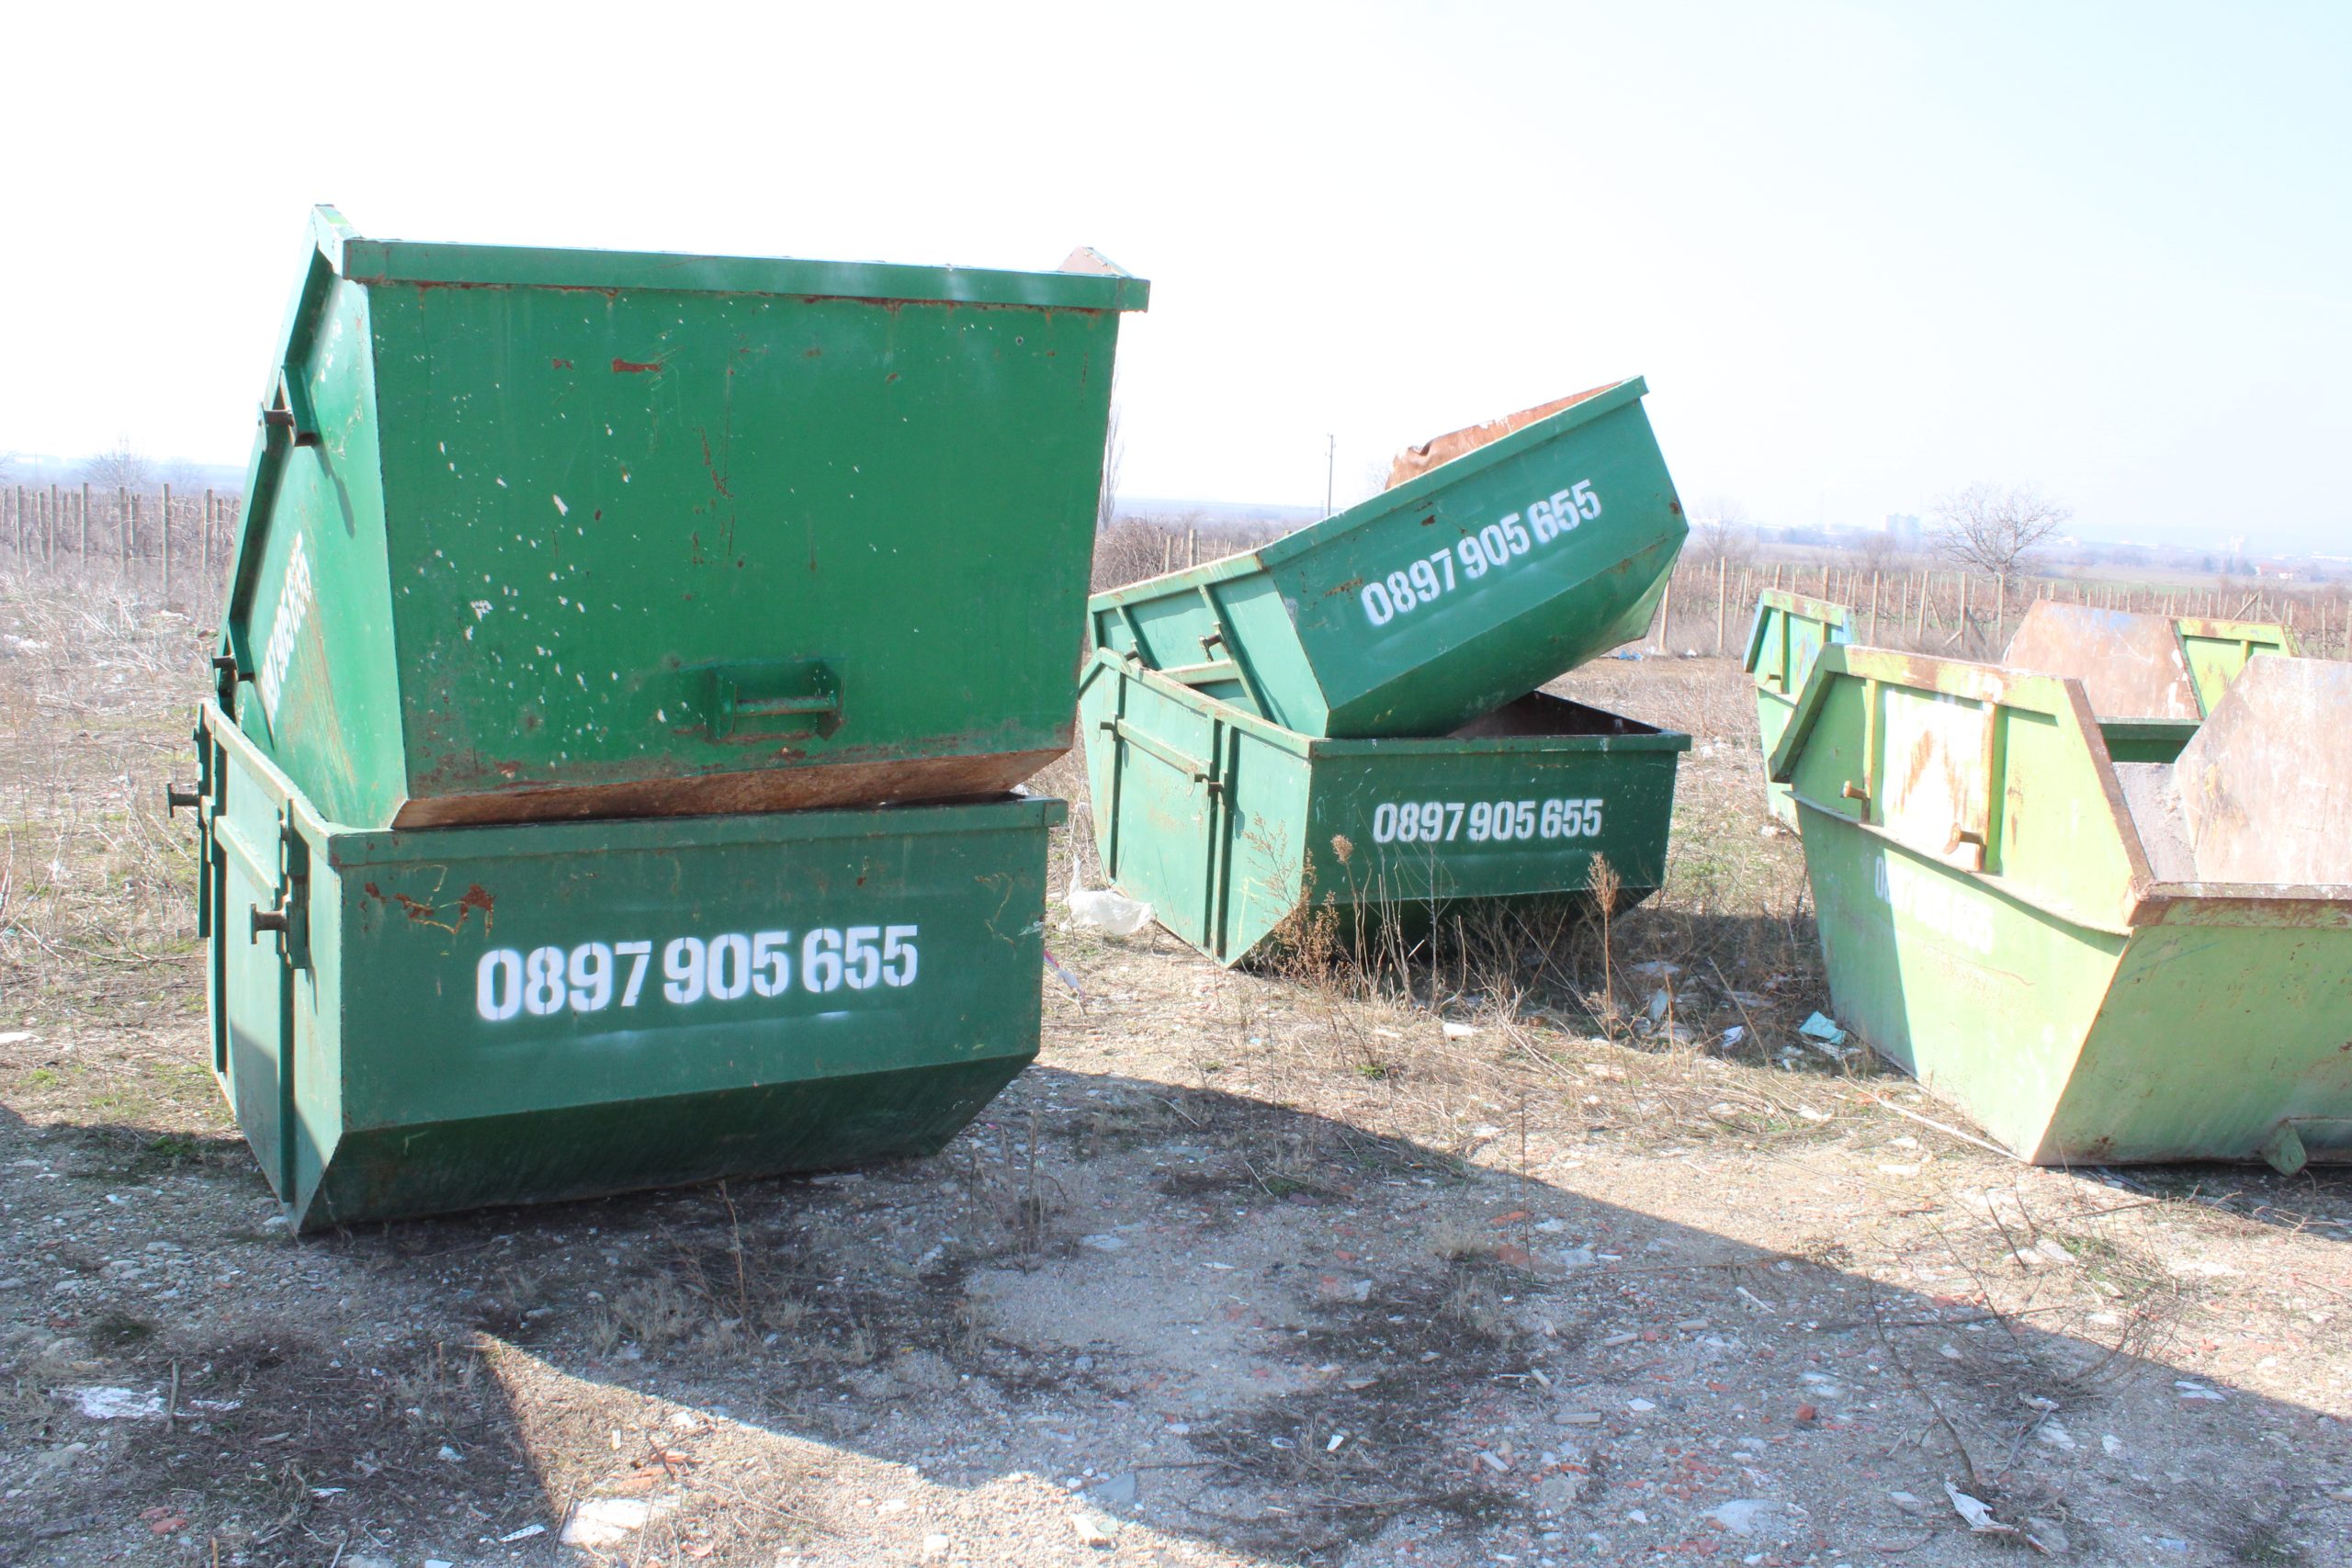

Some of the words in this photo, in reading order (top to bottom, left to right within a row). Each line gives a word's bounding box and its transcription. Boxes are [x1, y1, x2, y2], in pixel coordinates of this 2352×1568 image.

[1361, 547, 1455, 626] 0897
[1457, 513, 1531, 579] 905
[1527, 479, 1601, 543] 655
[1373, 801, 1465, 843] 0897
[1469, 800, 1536, 840] 905
[1540, 799, 1603, 838] 655
[476, 941, 651, 1021] 0897
[662, 931, 788, 1003] 905
[801, 924, 918, 993] 655
